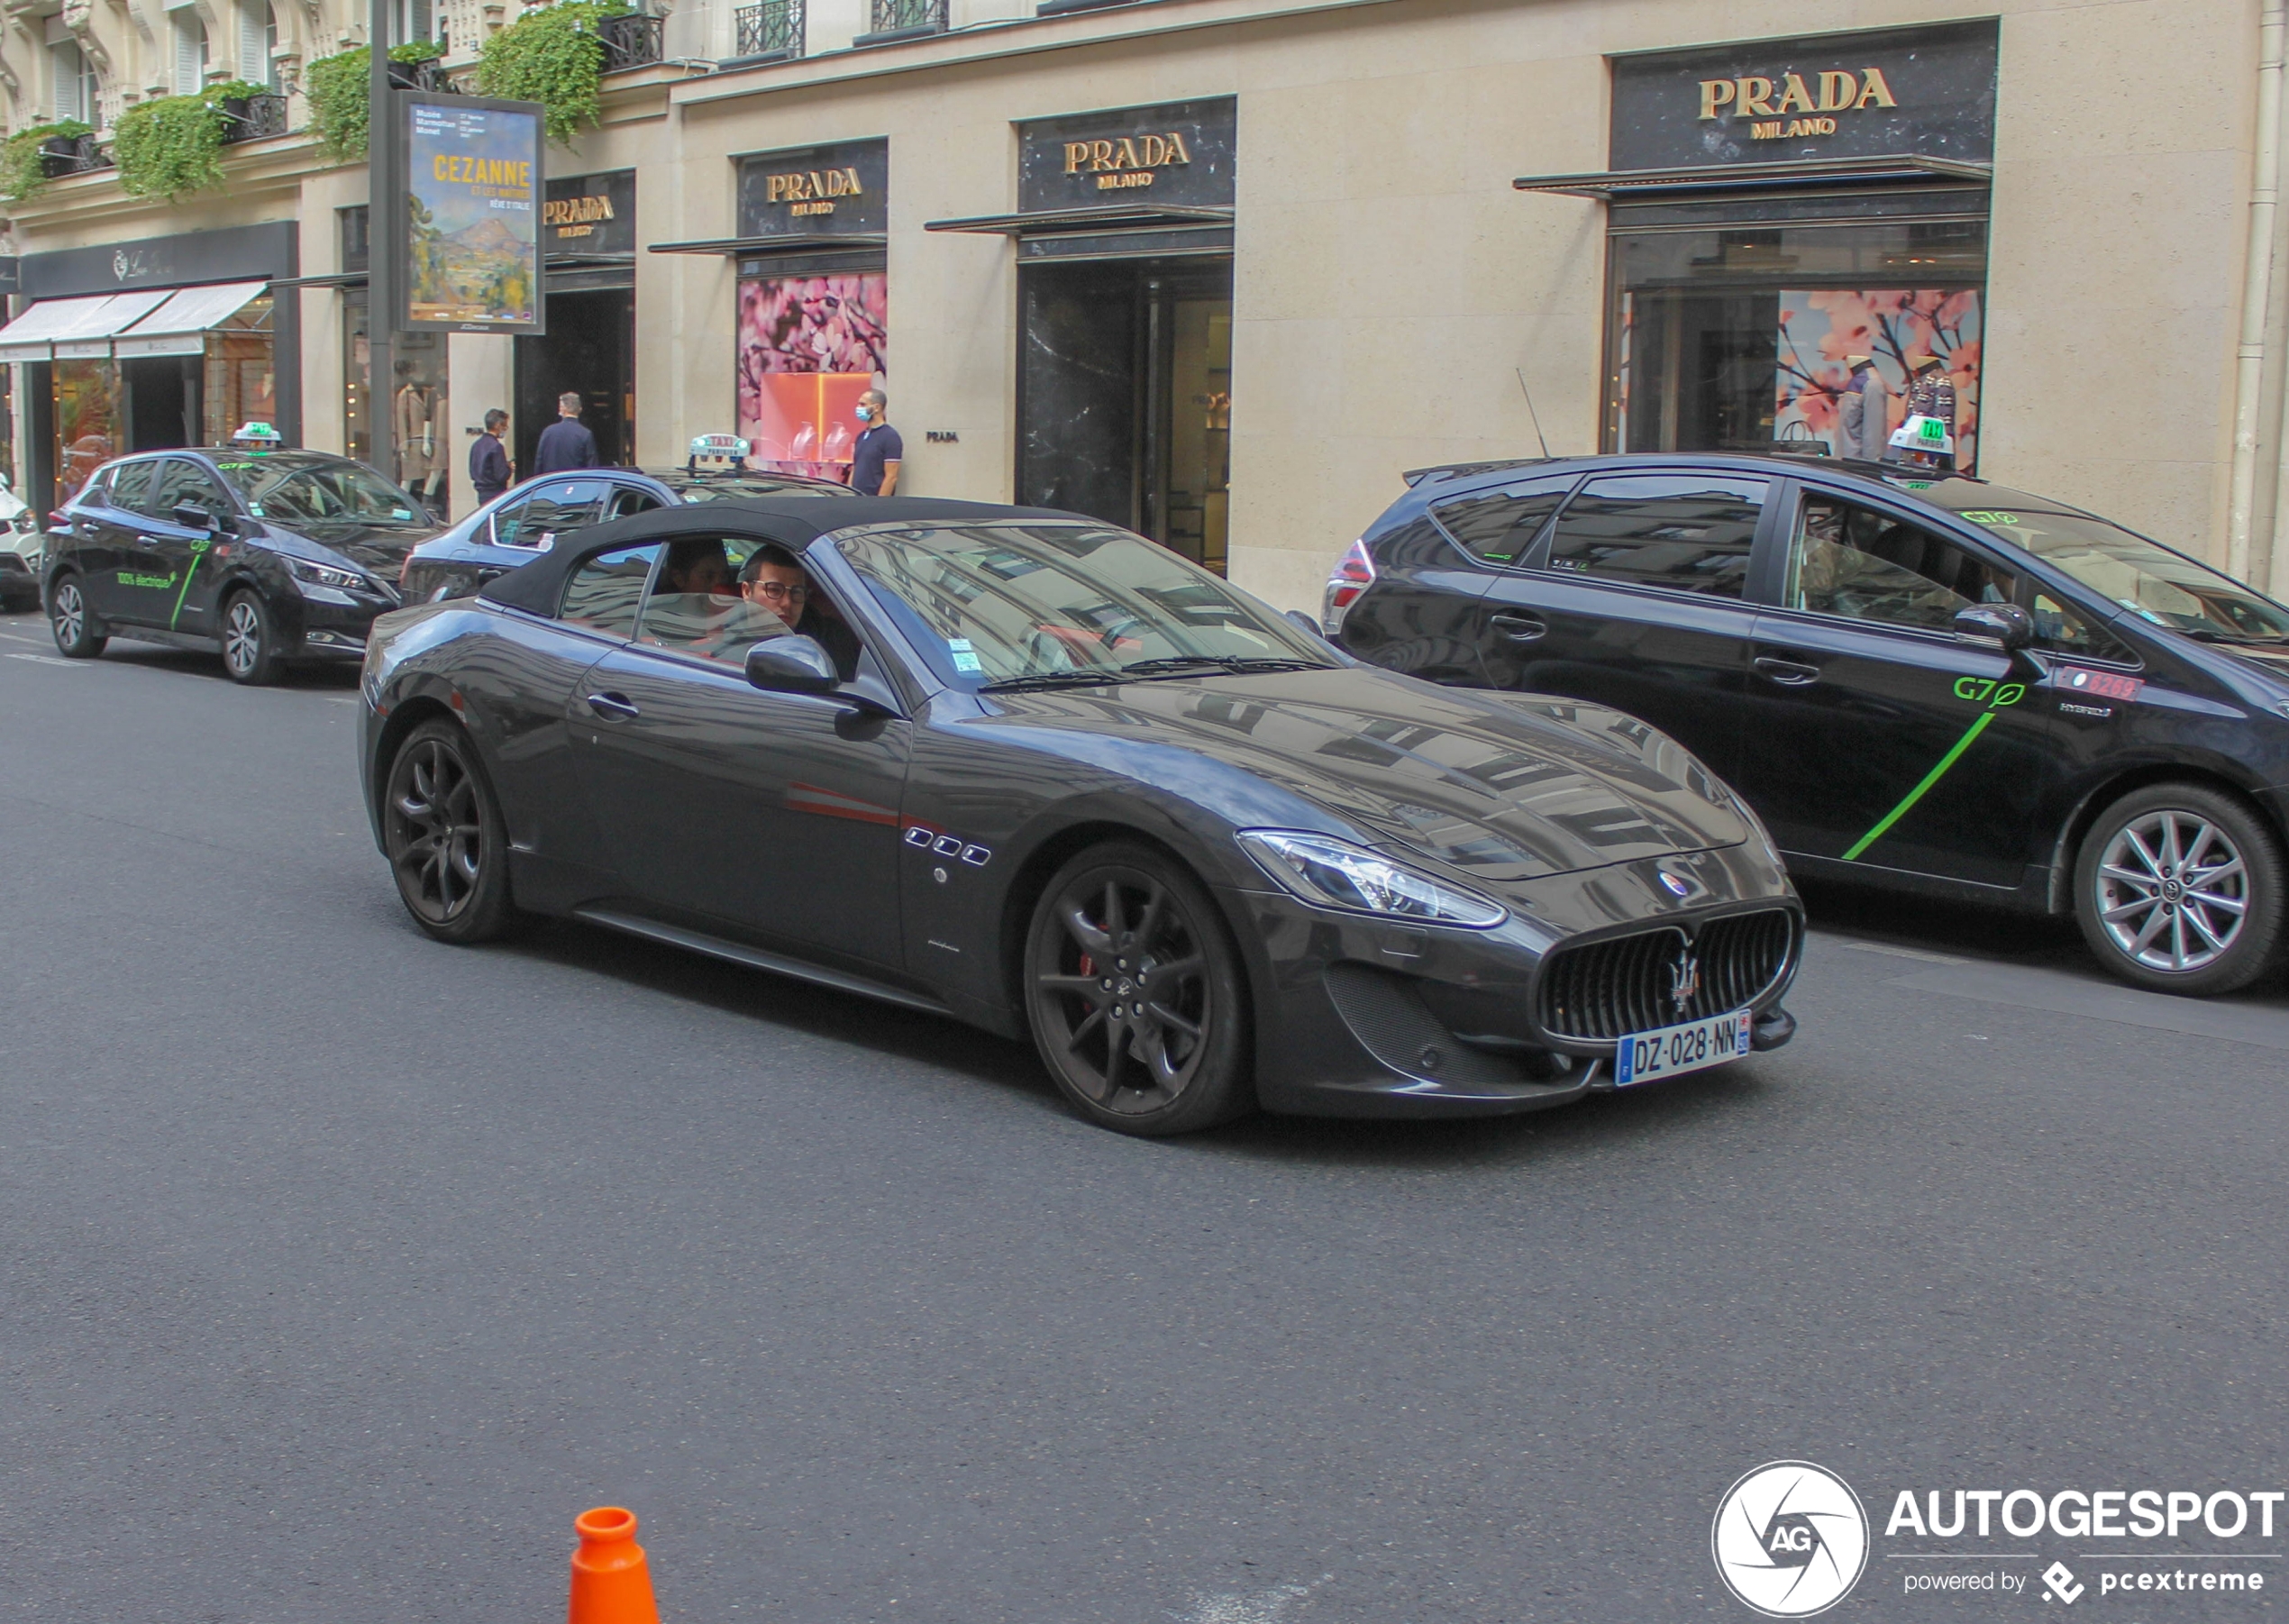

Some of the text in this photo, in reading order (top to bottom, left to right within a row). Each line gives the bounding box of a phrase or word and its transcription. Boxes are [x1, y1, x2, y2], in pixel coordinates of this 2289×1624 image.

[1698, 68, 1898, 120] PRADA
[1751, 116, 1837, 139] MILANO
[1062, 132, 1190, 174] PRADA
[433, 154, 531, 187] CEZANNE
[1097, 171, 1154, 189] MILANO
[766, 167, 862, 202] PRADA
[543, 195, 615, 225] PRADA
[791, 201, 834, 216] MILANO
[926, 431, 959, 443] PRADA
[1922, 419, 1943, 440] TAXI
[707, 448, 738, 456] PARISIEN
[709, 436, 734, 447] TAXI
[1917, 438, 1945, 449] PARISIEN
[1953, 677, 1998, 701] G7
[2088, 674, 2137, 698] 6269
